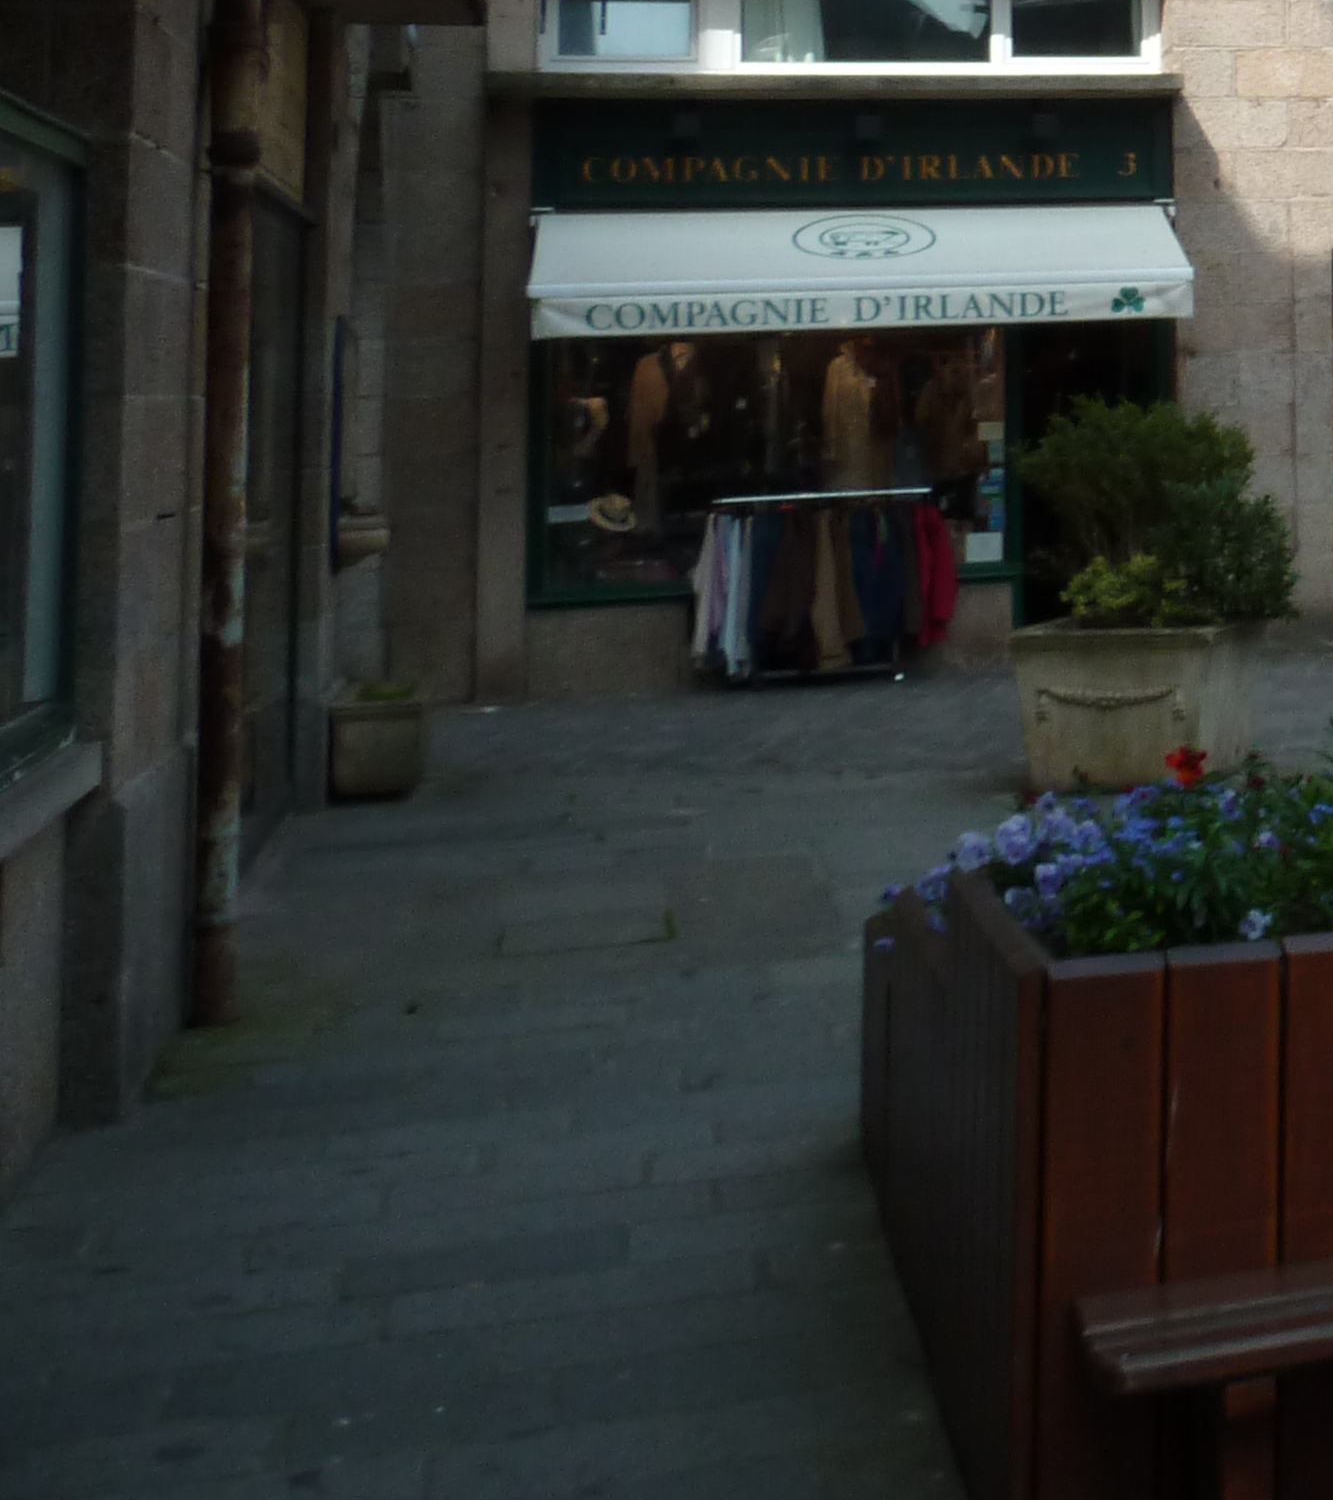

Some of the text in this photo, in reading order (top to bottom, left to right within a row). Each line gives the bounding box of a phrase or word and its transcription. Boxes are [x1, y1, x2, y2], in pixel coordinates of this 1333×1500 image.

[580, 151, 1138, 183] COMPAGNIE D'IRLANDE 3
[584, 290, 1069, 331] COMPAGNIE D'IRLANDE
